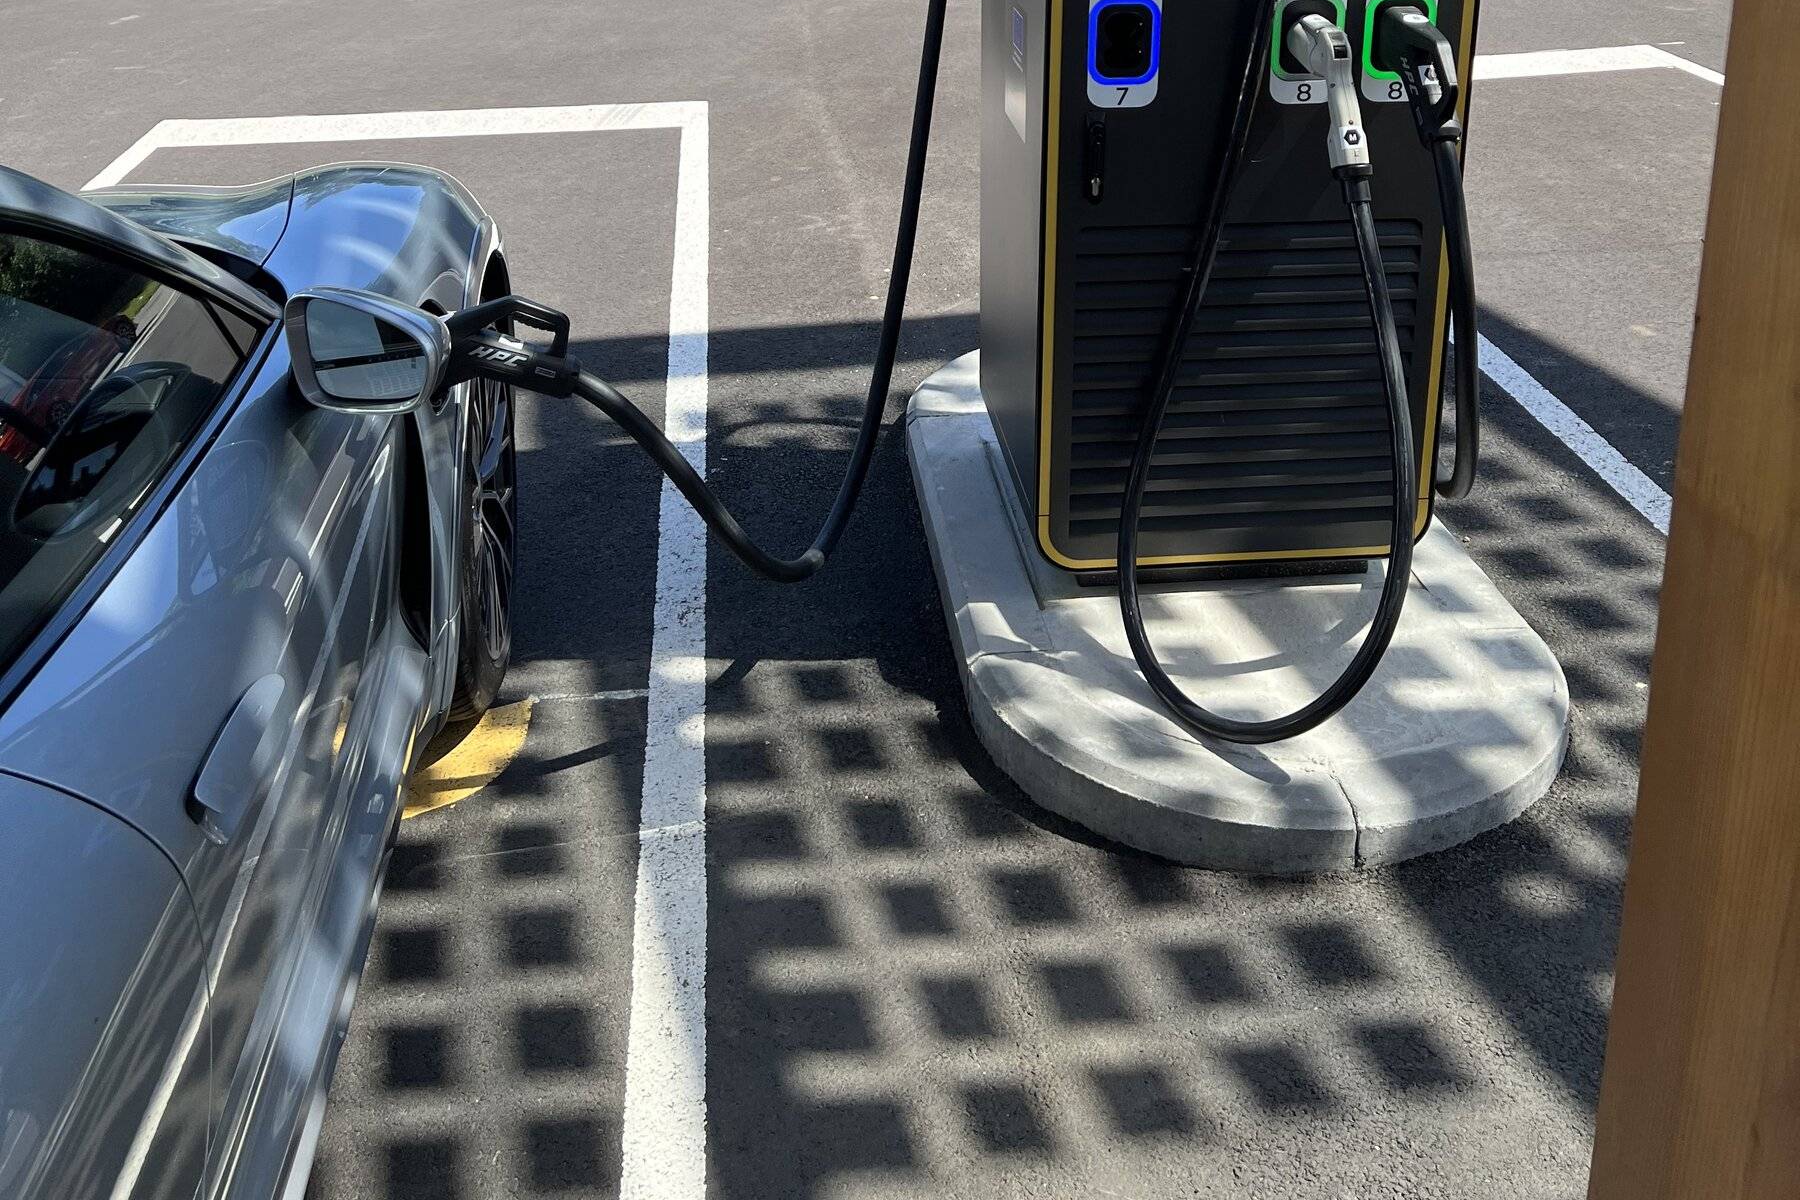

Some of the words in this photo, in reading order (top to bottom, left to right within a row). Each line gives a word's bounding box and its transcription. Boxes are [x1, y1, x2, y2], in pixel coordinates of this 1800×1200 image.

[1116, 87, 1129, 106] 7
[1297, 83, 1311, 102] 8
[1388, 81, 1402, 99] 8
[467, 346, 528, 367] HPC
